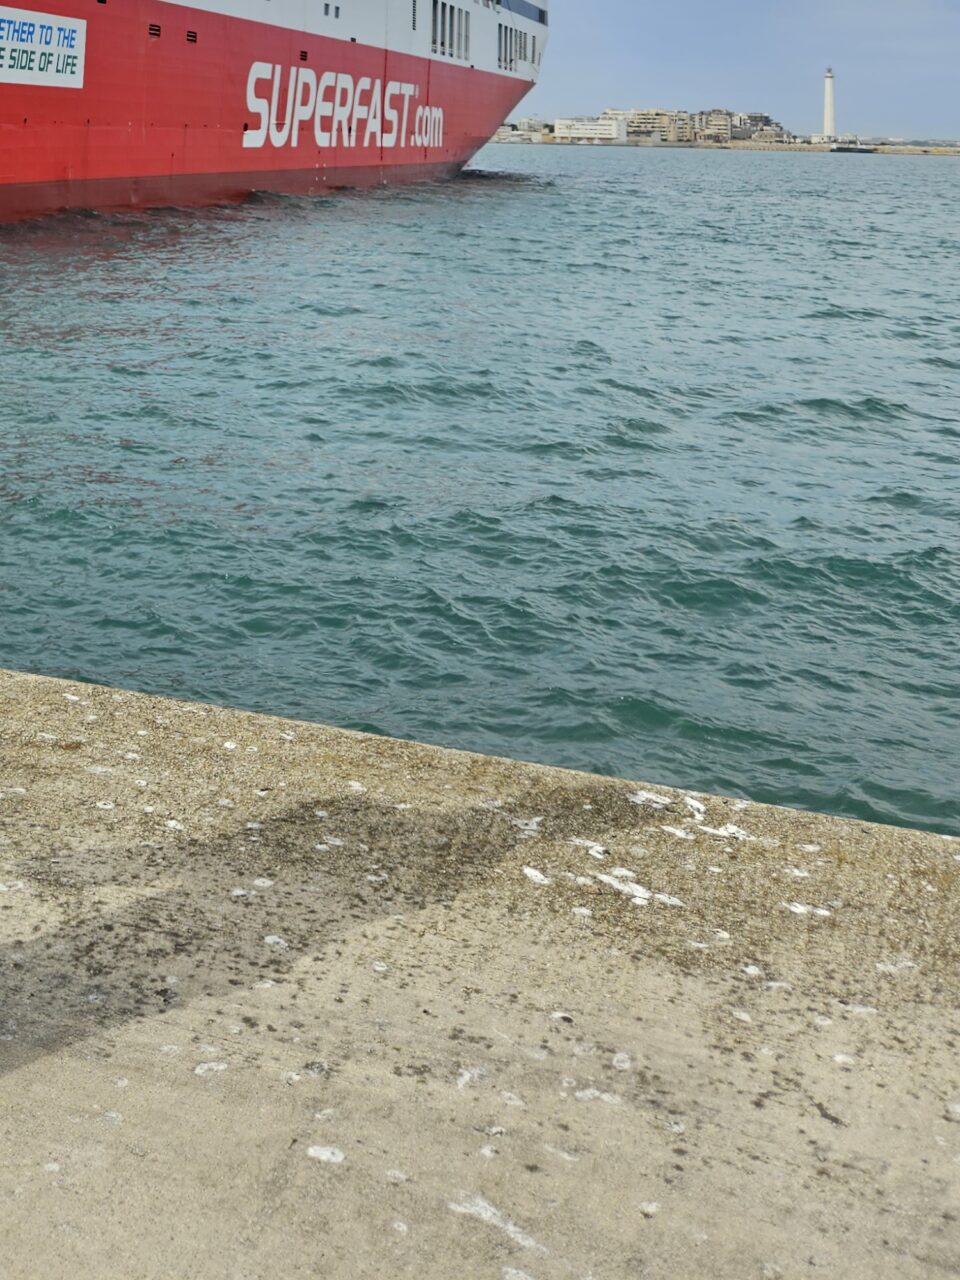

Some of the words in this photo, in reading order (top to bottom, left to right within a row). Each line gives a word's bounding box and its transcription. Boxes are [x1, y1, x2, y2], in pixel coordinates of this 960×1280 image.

[39, 24, 53, 46] TO
[56, 27, 77, 49] THE
[8, 48, 36, 71] SIDE
[39, 52, 54, 73] OF
[55, 55, 78, 75] LIFE
